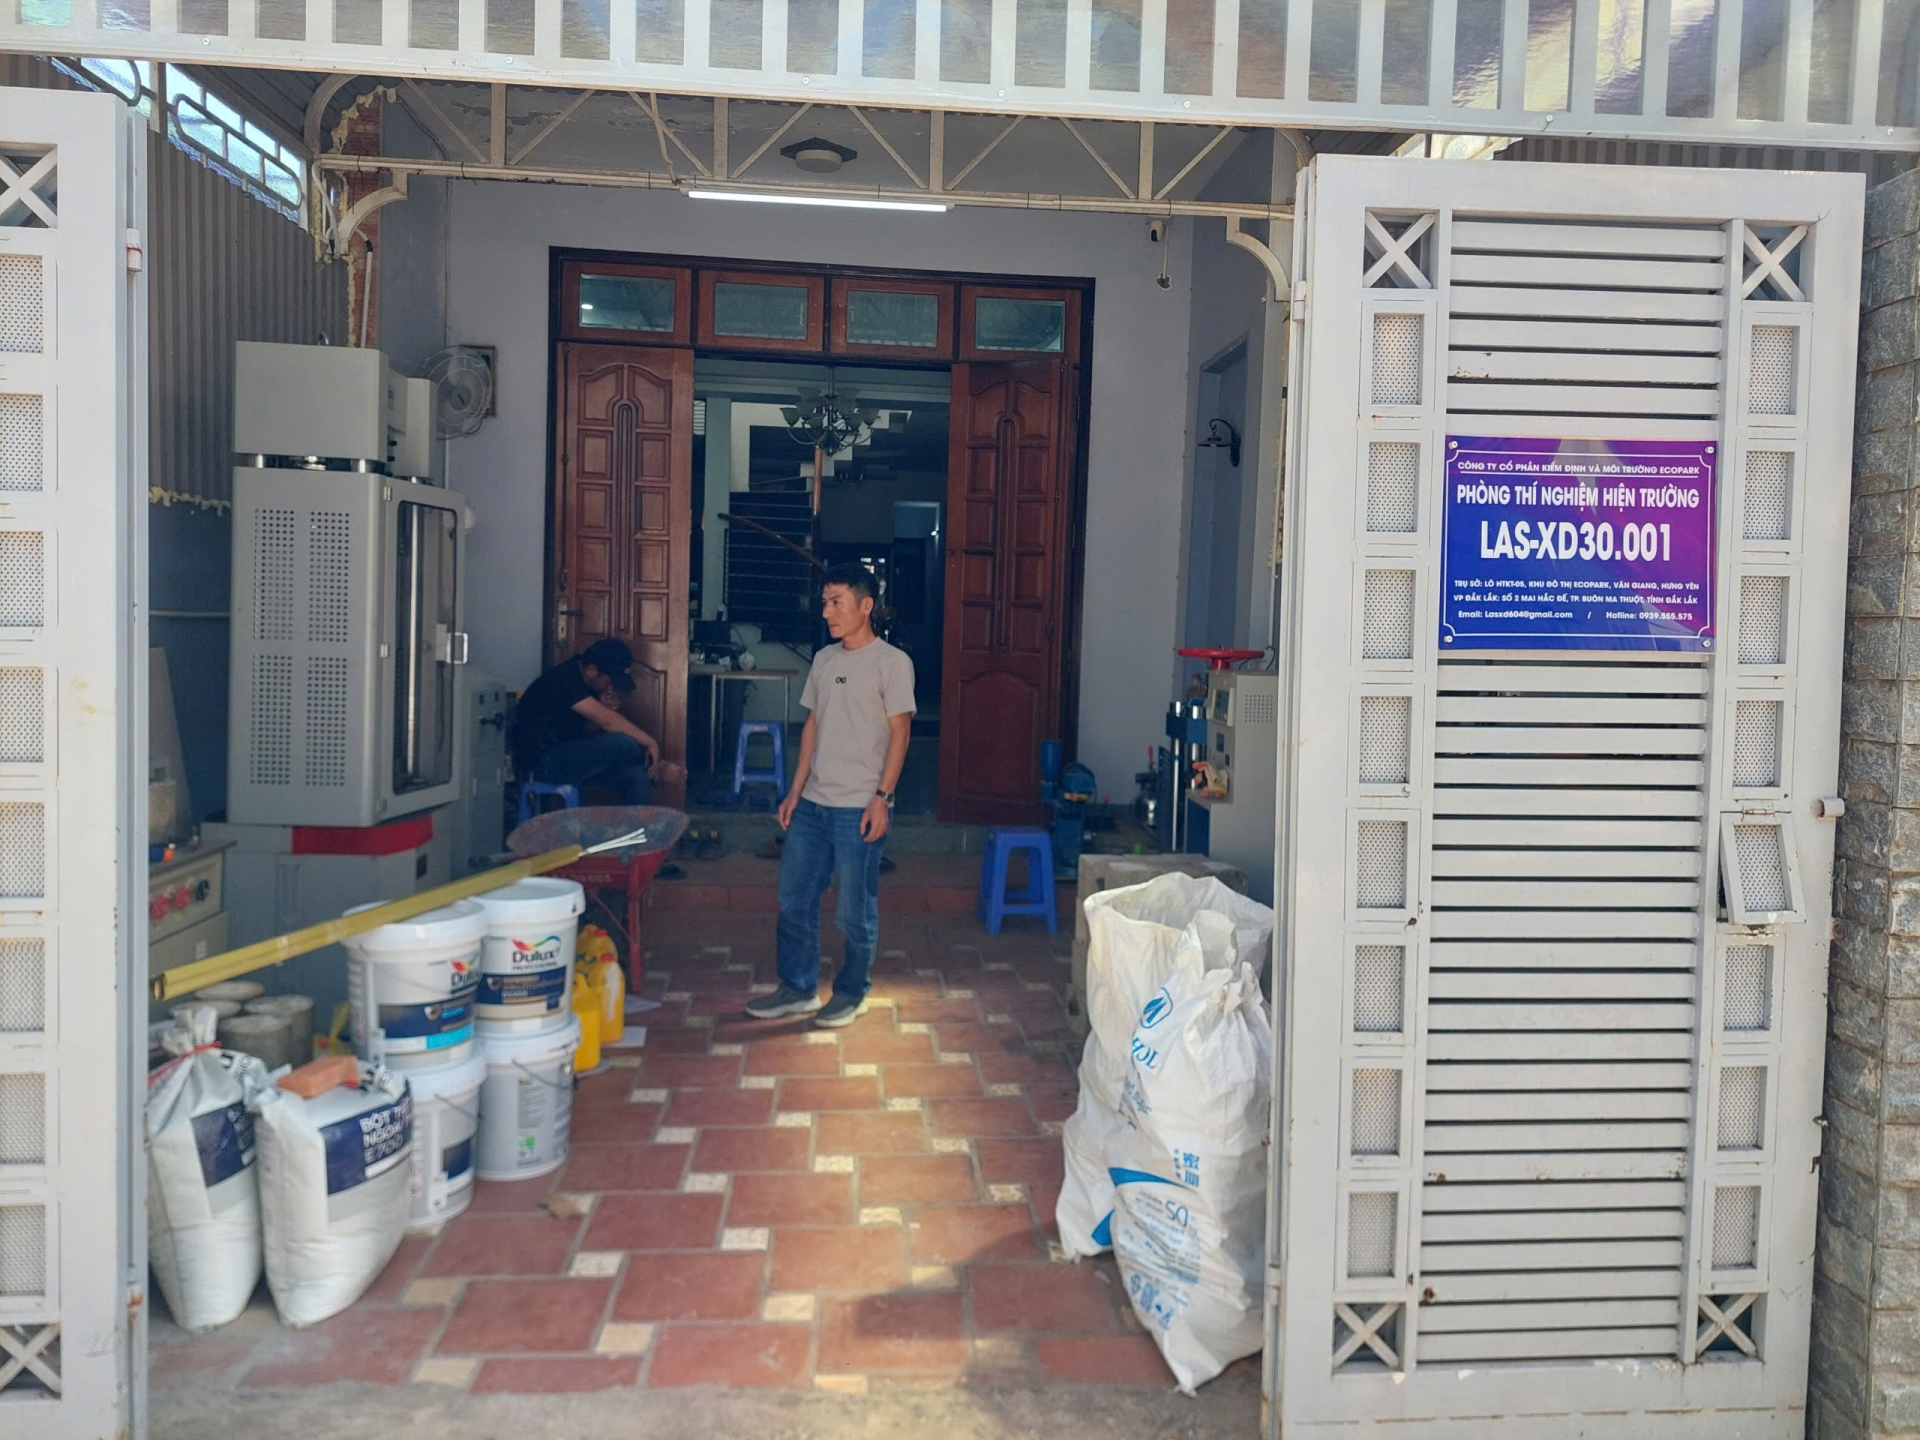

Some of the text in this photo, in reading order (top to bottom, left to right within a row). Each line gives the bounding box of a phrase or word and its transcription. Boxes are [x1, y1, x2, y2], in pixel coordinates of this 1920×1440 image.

[1458, 460, 1485, 470] CÔNG
[1564, 465, 1586, 474] ĐỊNH
[1588, 464, 1600, 473] VÀ
[1603, 464, 1620, 473] MÔI
[1622, 464, 1658, 474] TRƯỜNG
[1660, 466, 1700, 474] ECOPARK
[1457, 479, 1700, 512] PHÒNG THÍ NGHIỆM HIỆN TRƯỜNG
[1480, 521, 1670, 561] LAS-XD30.001
[1454, 580, 1468, 589] TRỤ
[1484, 579, 1494, 588] LÔ
[1546, 580, 1558, 588] ĐÔ
[1560, 581, 1572, 589] THỊ
[1574, 581, 1612, 589] ECOPARK,
[1614, 580, 1630, 589] VĂN
[1631, 582, 1660, 590] GIANG,
[1661, 582, 1683, 590] HƯNG
[1685, 582, 1699, 590] YÊN
[1502, 592, 1512, 602] SỐ
[1537, 592, 1555, 602] HẮC
[1582, 594, 1604, 603] BUÔN
[1666, 594, 1682, 604] ĐẮK
[1684, 595, 1698, 604] LẮK
[1458, 610, 1483, 618] Email:
[1639, 612, 1692, 620] 0939.555.575
[512, 950, 555, 964] Dulux
